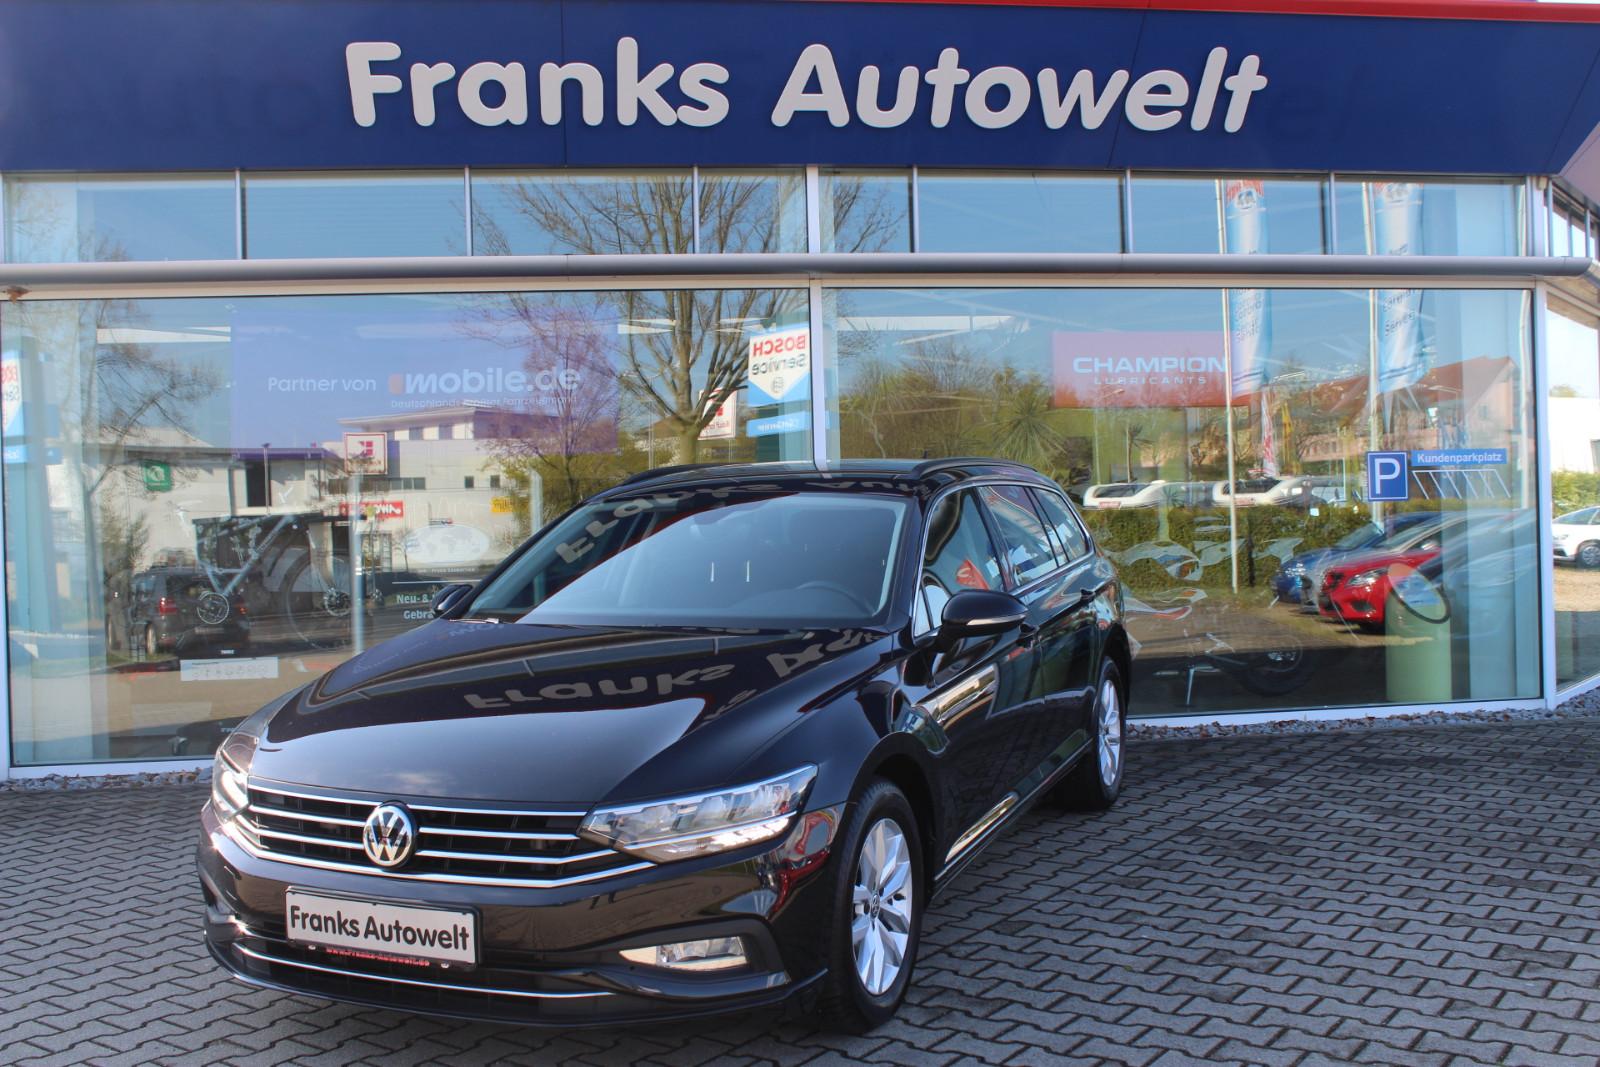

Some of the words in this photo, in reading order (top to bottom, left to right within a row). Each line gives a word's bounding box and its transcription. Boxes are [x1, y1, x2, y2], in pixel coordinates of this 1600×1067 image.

[344, 37, 730, 127] Franks
[771, 44, 1268, 133] Autowelt
[1072, 356, 1227, 373] CHAMPION
[268, 376, 337, 392] Partner
[341, 378, 377, 392] von
[405, 367, 581, 394] mobile.de
[1094, 376, 1207, 385] LUBRICANTS
[1417, 453, 1503, 464] Kundenparkplatz
[1374, 457, 1401, 495] P
[396, 594, 420, 604] Neu-
[403, 610, 434, 620] Gebra
[290, 905, 361, 938] Franks
[363, 916, 470, 951] Autowelt
